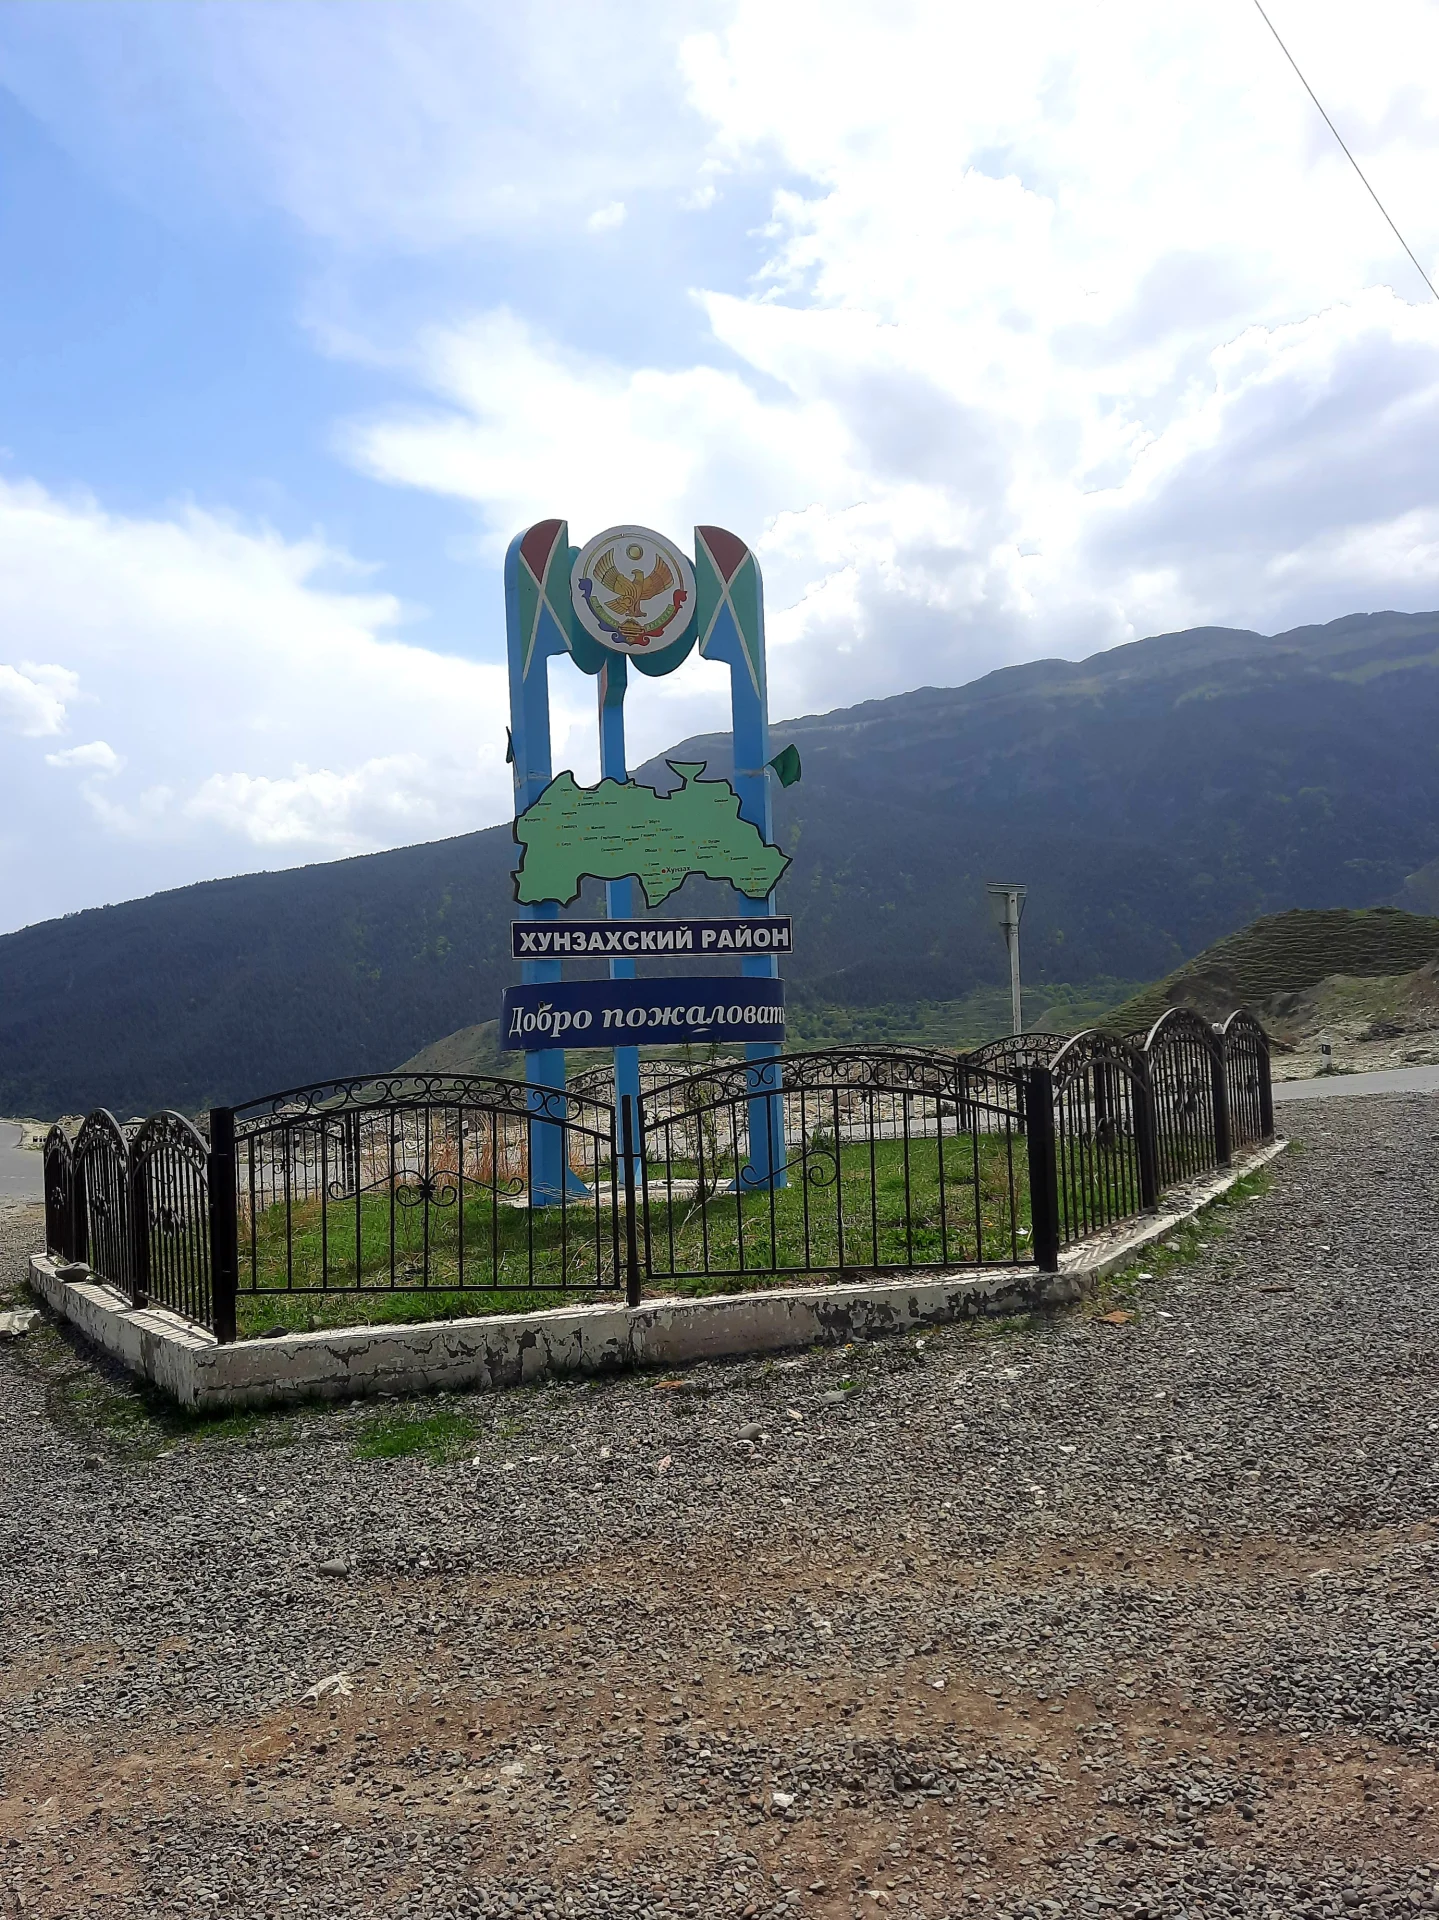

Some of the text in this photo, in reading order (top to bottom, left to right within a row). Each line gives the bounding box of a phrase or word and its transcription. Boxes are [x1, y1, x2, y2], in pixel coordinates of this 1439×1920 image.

[519, 924, 789, 951] ХУНЗАХСКИЙ РАЙОН
[509, 1002, 593, 1038] Добро
